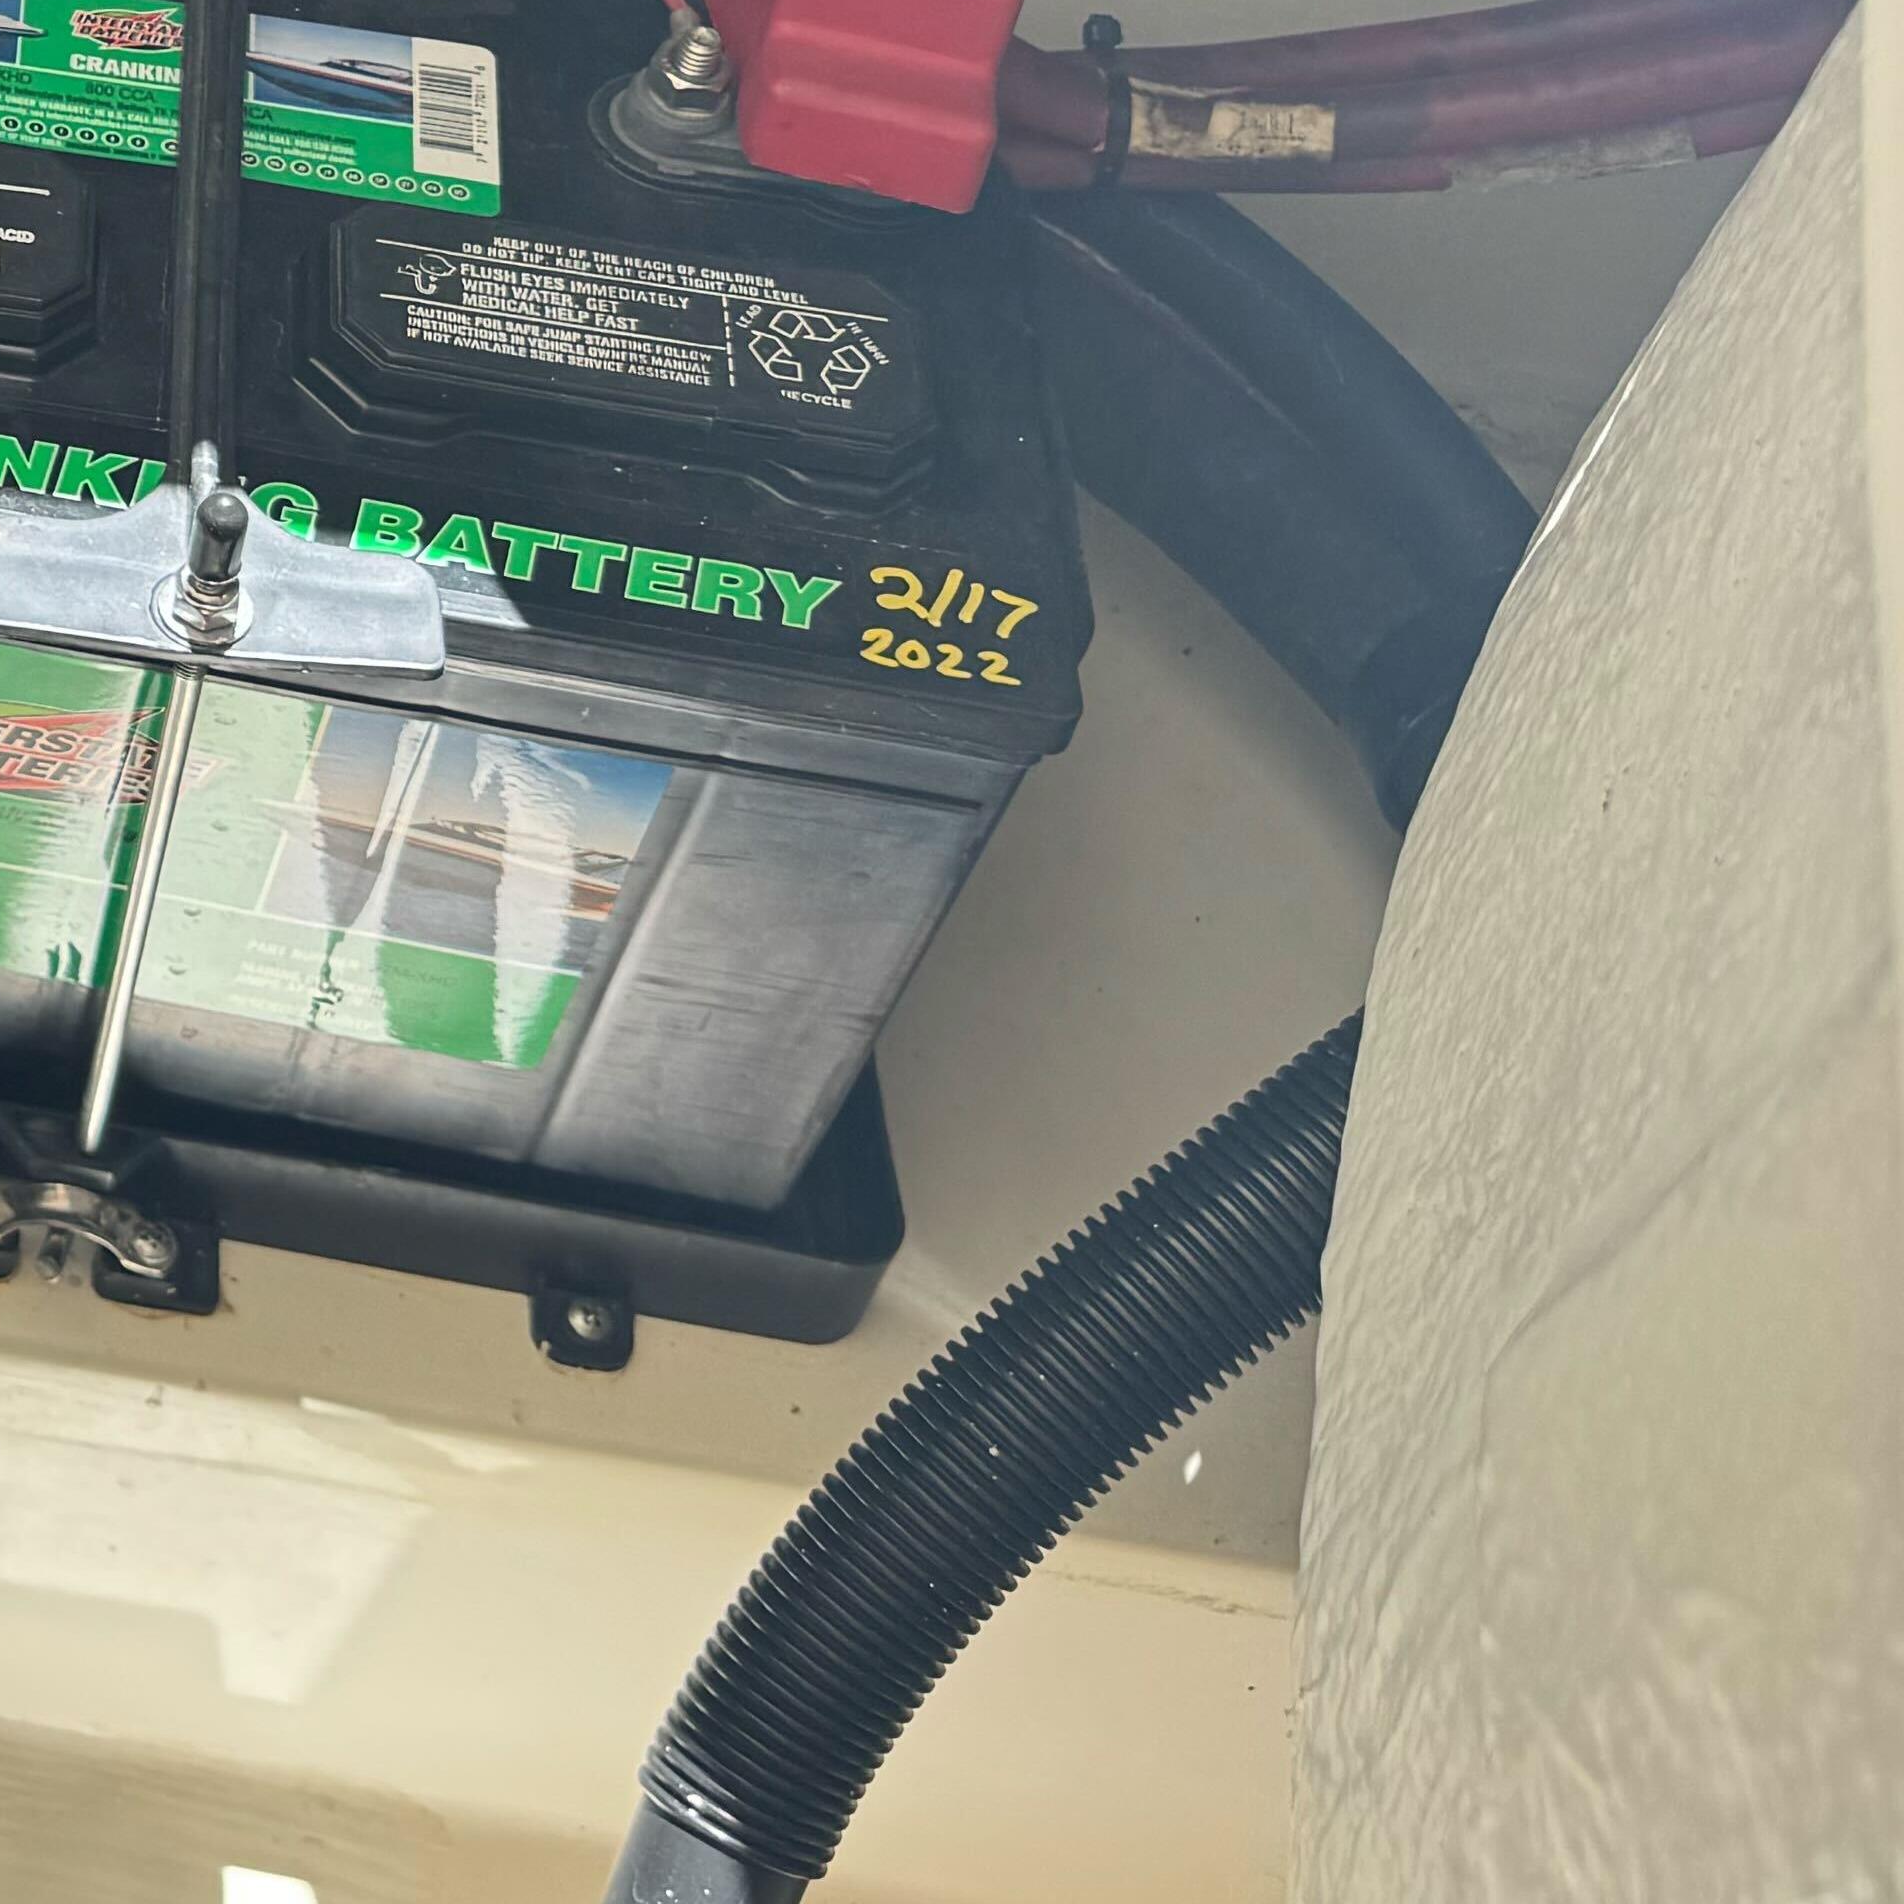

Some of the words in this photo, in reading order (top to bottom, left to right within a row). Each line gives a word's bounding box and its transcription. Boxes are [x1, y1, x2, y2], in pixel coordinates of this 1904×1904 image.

[118, 86, 156, 102] CCA
[460, 263, 517, 285] FLUSH
[521, 272, 564, 289] EYES
[570, 279, 689, 310] IMMEDIATELY
[493, 236, 529, 251] KEEP
[593, 250, 620, 264] THE
[624, 255, 673, 273] REACH
[700, 267, 775, 289] CHILDREN
[556, 256, 591, 271] KEEP
[596, 262, 633, 279] VENT
[638, 269, 675, 285] CAPS
[680, 275, 723, 292] TIGHT
[729, 281, 758, 296] AND
[764, 287, 808, 305] LEVEL
[461, 279, 507, 297] WITH
[587, 298, 620, 314] GET
[462, 292, 541, 316] MEDICAL
[545, 305, 590, 324] HELP
[594, 312, 639, 331] FAST
[408, 317, 507, 343] INSTRUCTIONS
[527, 336, 585, 356] VEHICLE
[588, 346, 647, 365] OWNERS
[650, 355, 710, 375] MANUAL
[454, 334, 526, 357] AVAILABLE
[568, 354, 625, 375] SERVICE
[628, 364, 712, 387] ASSISTANCE
[474, 315, 502, 329] FOR
[505, 320, 539, 336] SAFE
[543, 327, 581, 343] JUMP
[584, 334, 652, 353] STARTING
[656, 344, 712, 362] FOLLOW
[781, 389, 853, 410] RECYCLE
[353, 497, 841, 631] BATTERY
[866, 566, 1039, 640] 2/17
[858, 626, 1022, 687] 2022
